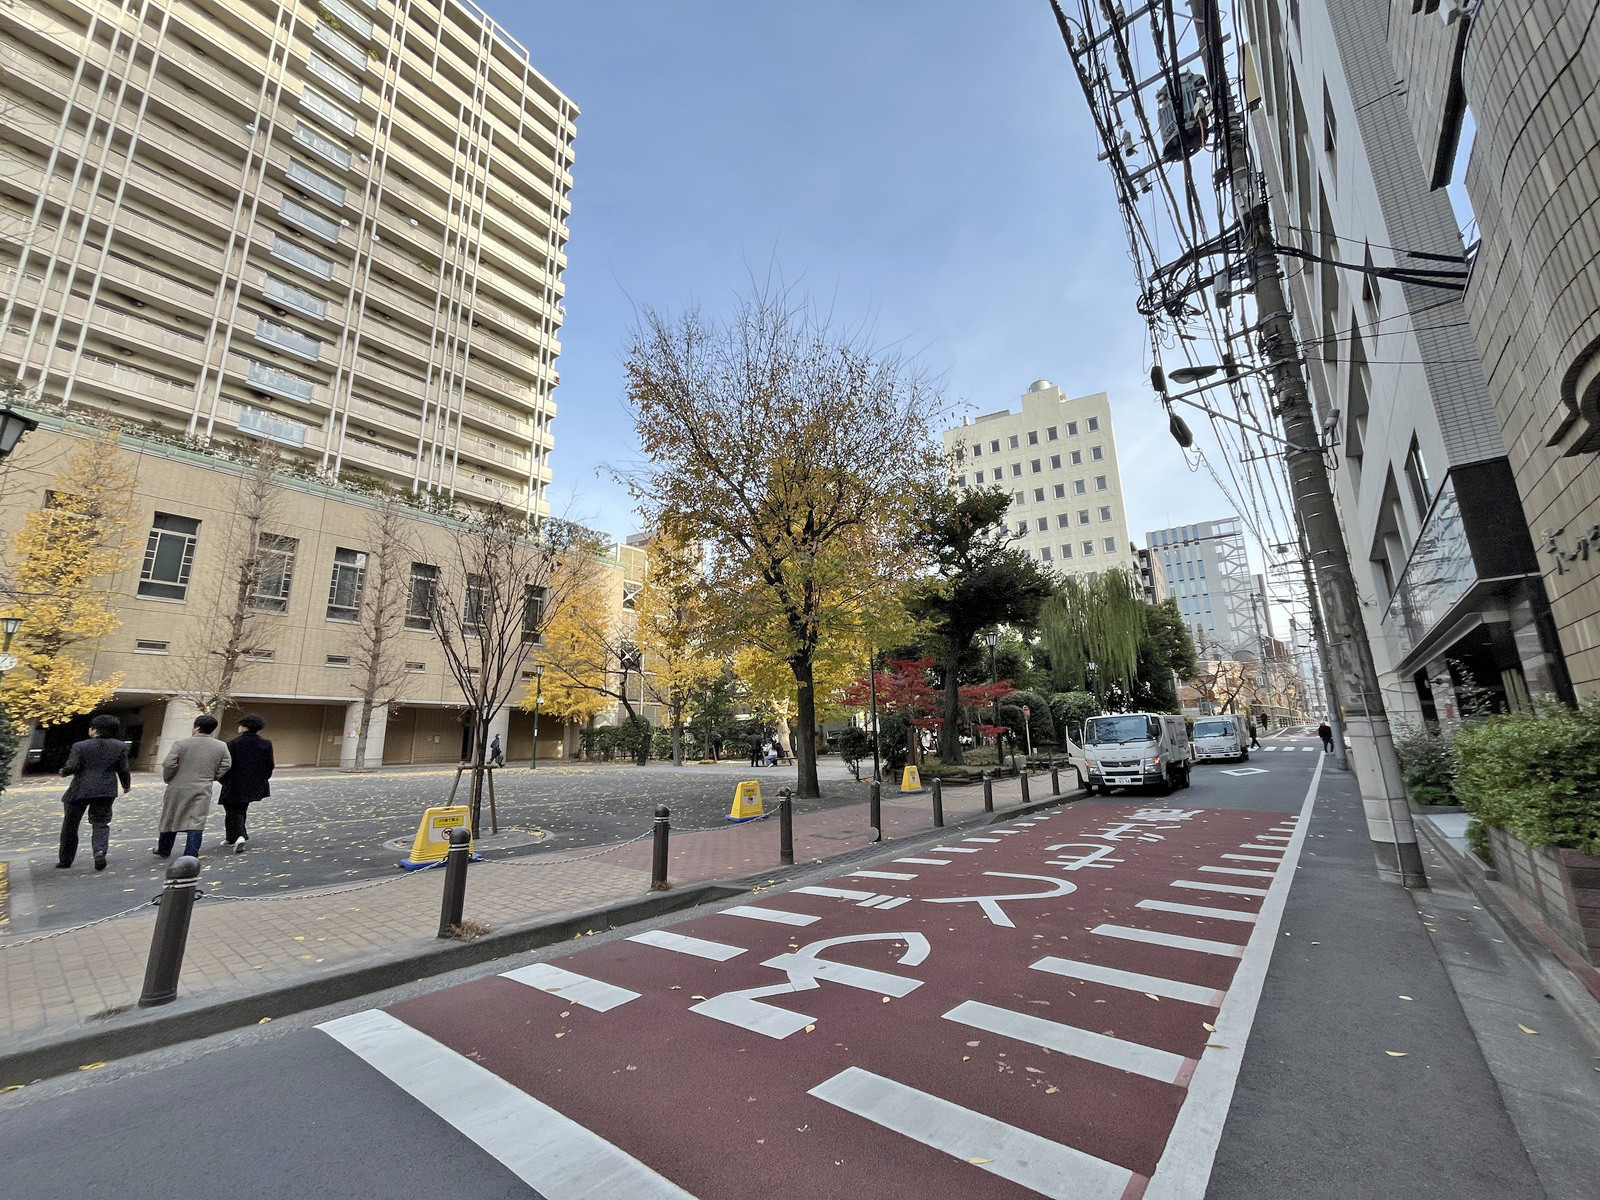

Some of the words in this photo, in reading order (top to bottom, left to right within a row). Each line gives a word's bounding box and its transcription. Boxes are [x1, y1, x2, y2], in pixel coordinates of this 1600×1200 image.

[688, 808, 1205, 1040] 子ども注意
